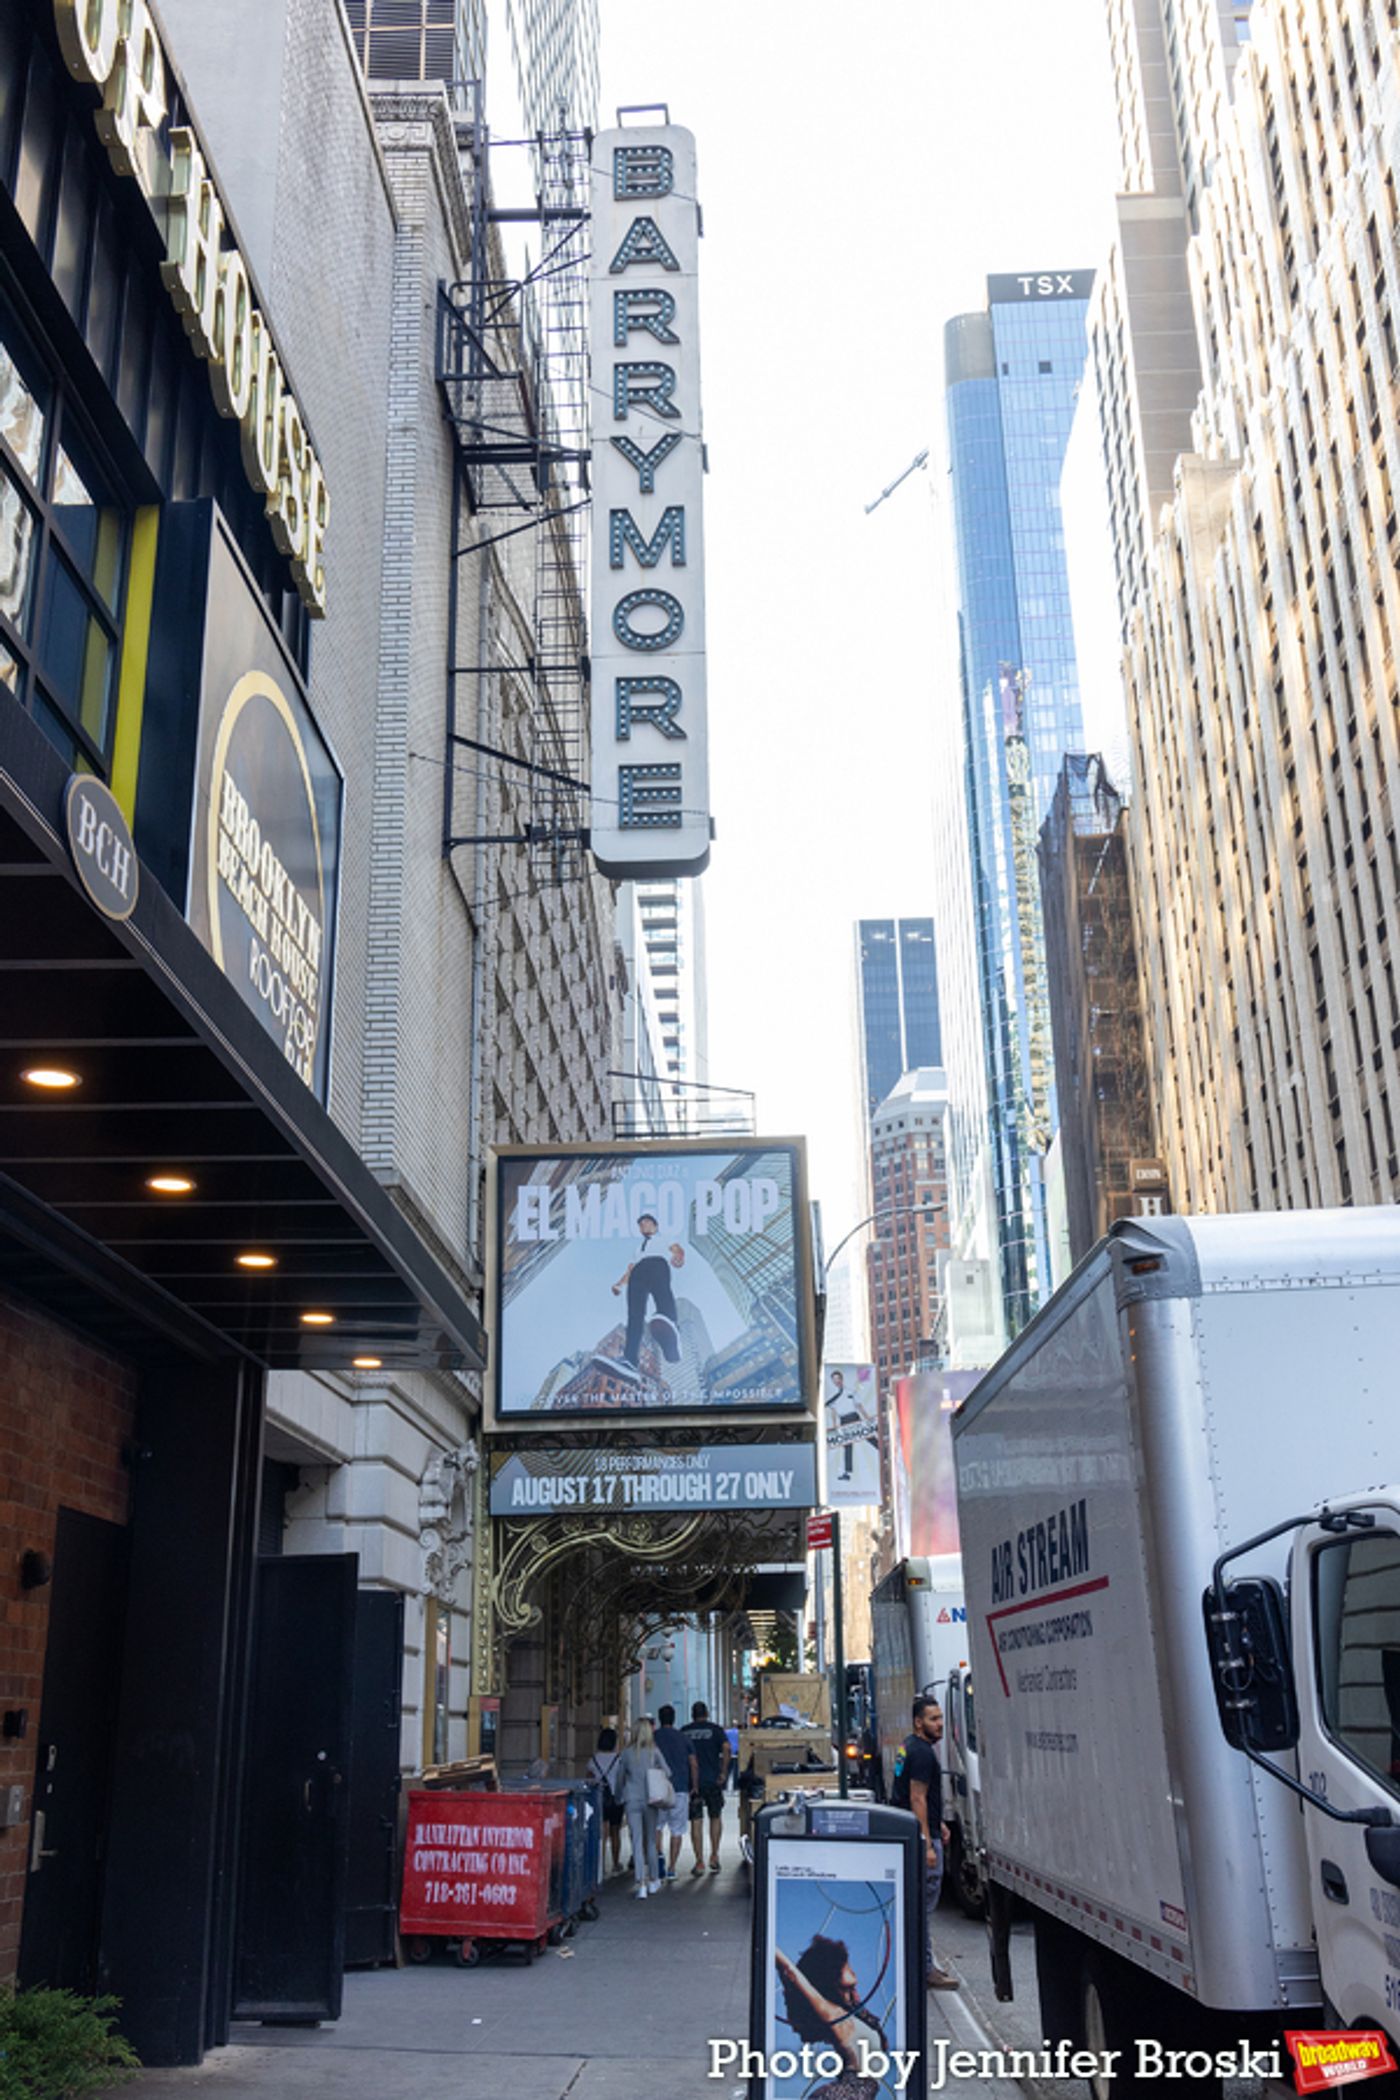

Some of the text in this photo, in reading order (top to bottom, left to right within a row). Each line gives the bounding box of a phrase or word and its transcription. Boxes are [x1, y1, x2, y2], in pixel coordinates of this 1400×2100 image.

[1017, 275, 1074, 295] TSX
[609, 145, 687, 831] BARRYMORE
[77, 793, 131, 899] BCH
[219, 769, 323, 974] BROOKLYN
[270, 911, 319, 1014] HOUSE
[517, 1184, 559, 1241] EL
[695, 1178, 780, 1236] POP
[511, 1470, 795, 1506] AUGUST 17 THROUGH 27 ONLY
[991, 1498, 1089, 1604] AIR STREAM
[414, 1850, 489, 1873] CONTRACTING
